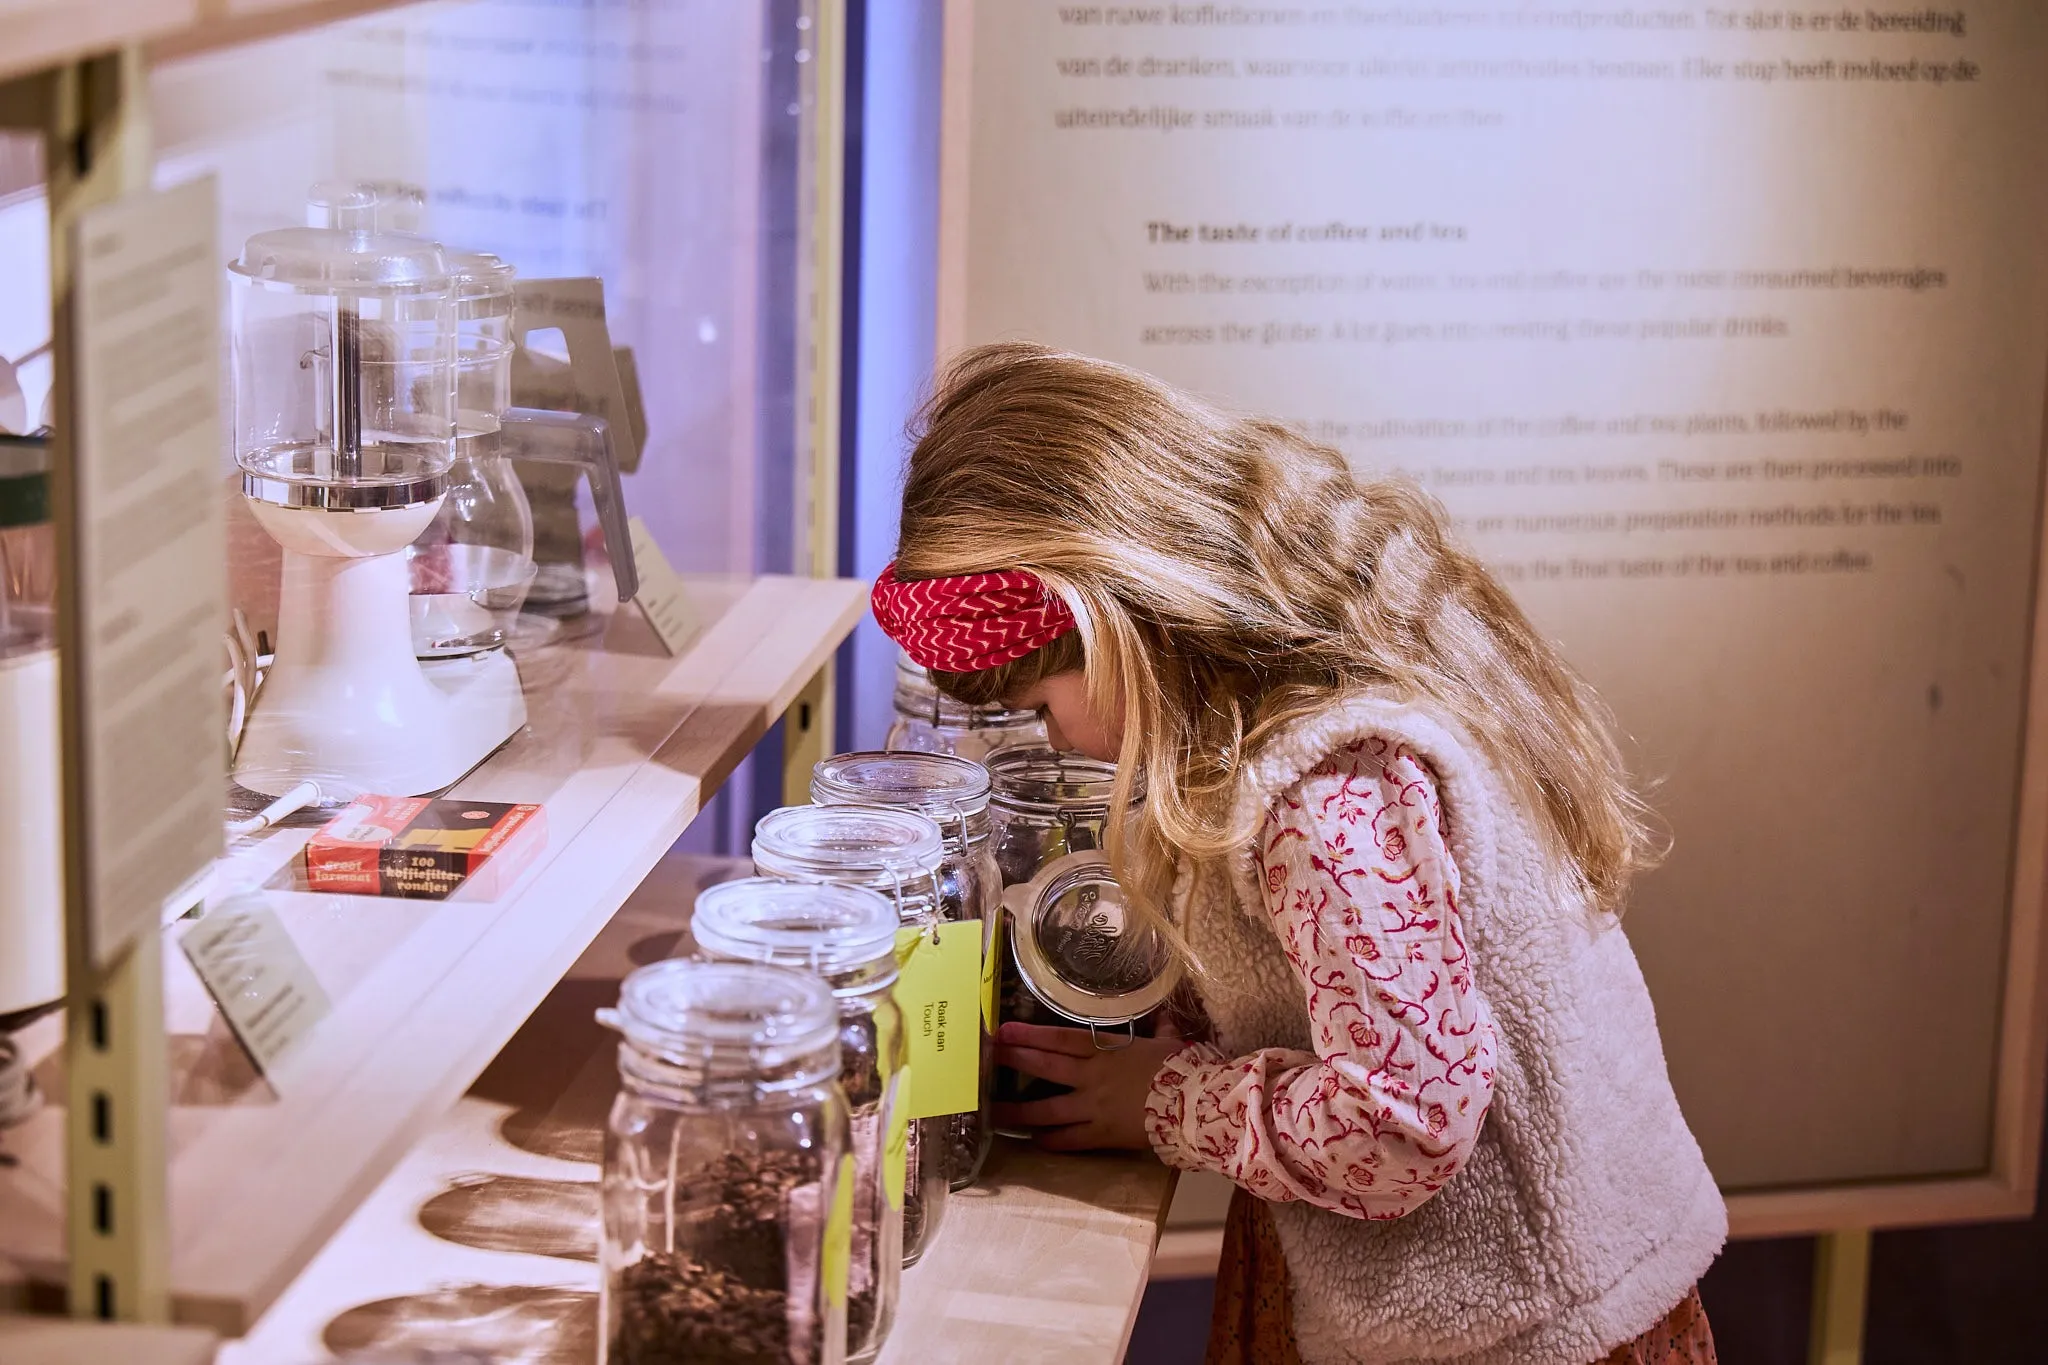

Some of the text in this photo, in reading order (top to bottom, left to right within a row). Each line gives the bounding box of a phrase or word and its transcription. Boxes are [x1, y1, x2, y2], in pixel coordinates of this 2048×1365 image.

[1145, 222, 1192, 243] The
[1198, 222, 1259, 243] taste
[1297, 222, 1369, 243] coffee
[1379, 222, 1424, 243] and
[1429, 222, 1467, 243] tea
[411, 857, 435, 867] 100
[397, 881, 448, 893] rondjes
[923, 1002, 934, 1037] Touch
[936, 1001, 948, 1052] Raak aan
